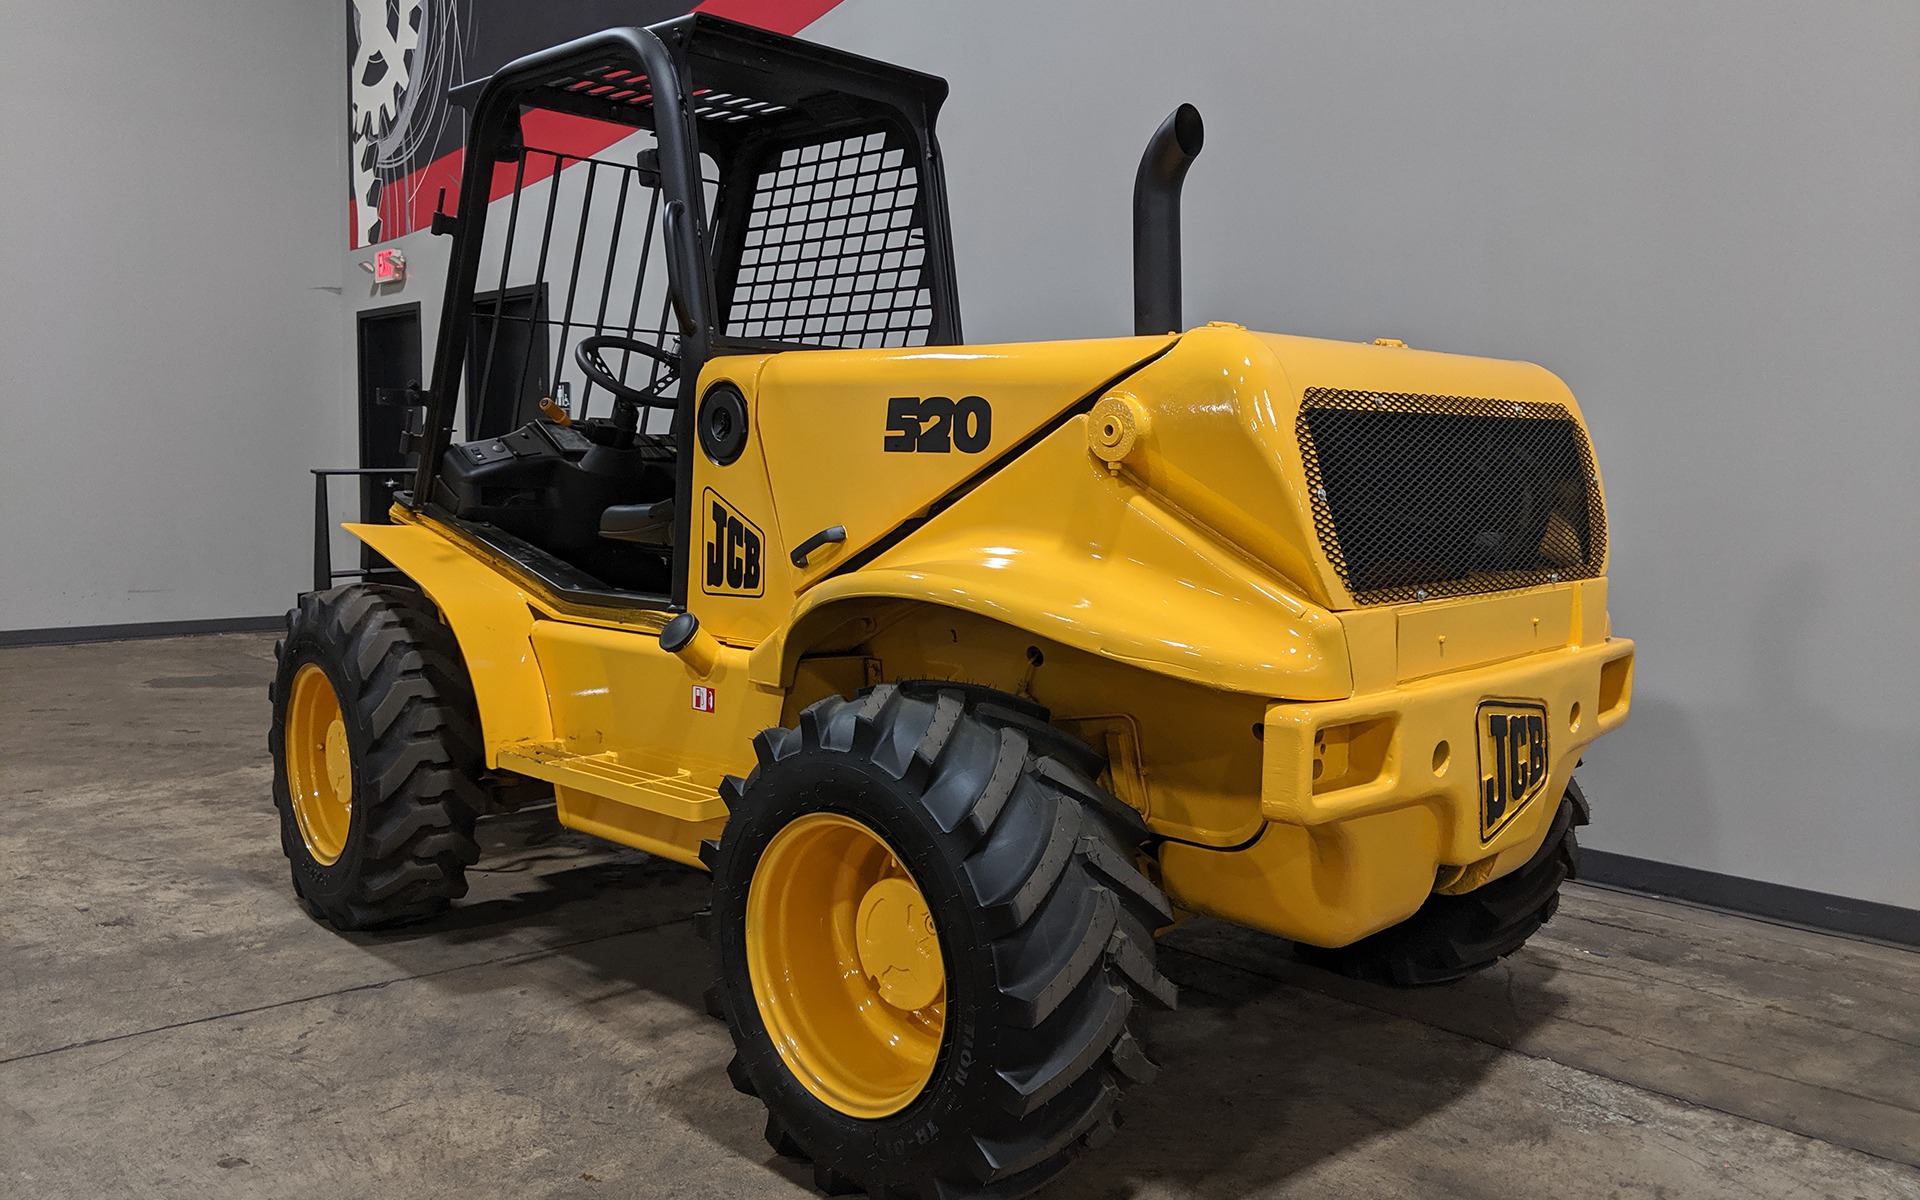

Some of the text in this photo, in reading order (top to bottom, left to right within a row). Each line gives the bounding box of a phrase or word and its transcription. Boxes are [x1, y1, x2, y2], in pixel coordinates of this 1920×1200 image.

[884, 396, 991, 453] 520
[707, 500, 760, 589] JCB
[1485, 714, 1544, 829] JCB
